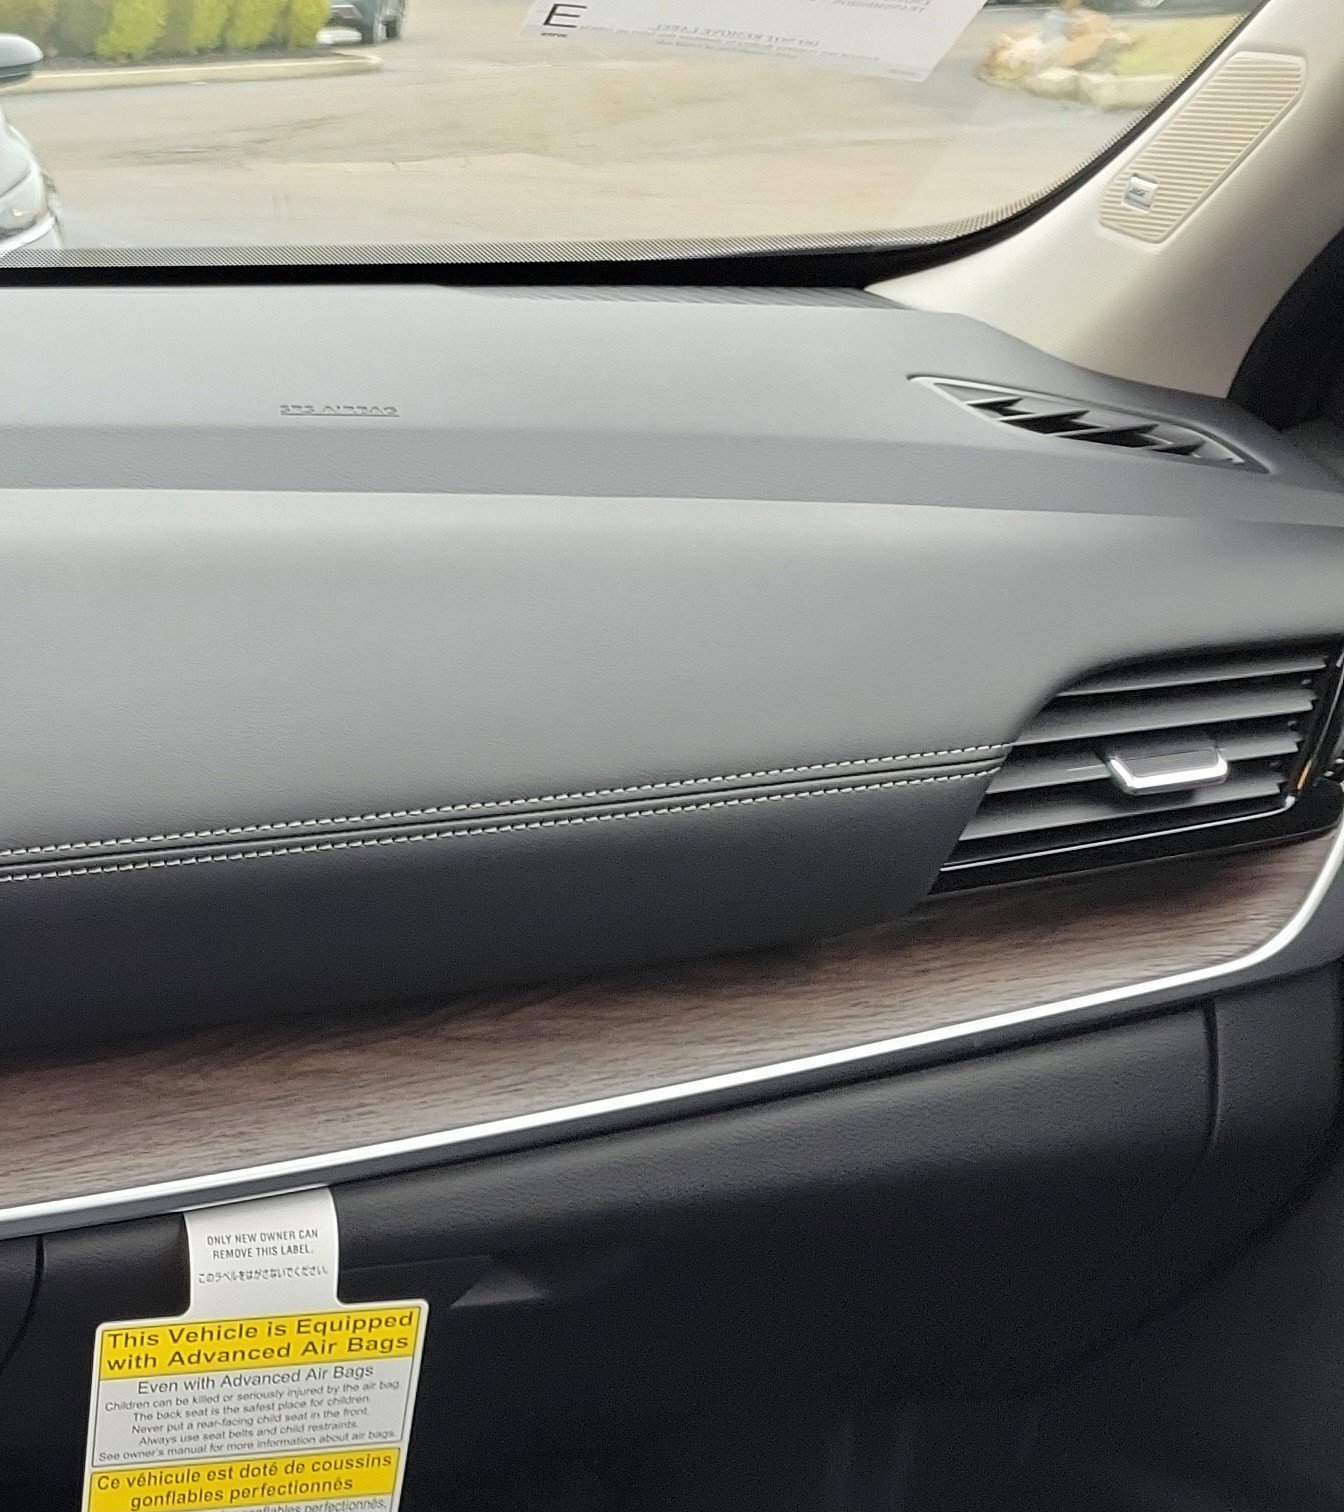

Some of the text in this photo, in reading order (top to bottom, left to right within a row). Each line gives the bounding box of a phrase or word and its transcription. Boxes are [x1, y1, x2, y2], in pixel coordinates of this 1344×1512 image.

[207, 1228, 317, 1246] ONLY NEW OWNER CAN
[212, 1247, 252, 1260] REMOVE
[256, 1245, 277, 1258] THIS
[108, 1312, 412, 1349] This Vehicle is Equipped
[107, 1334, 407, 1372] with Advanced Air Bags
[138, 1364, 373, 1395] Even with Advanced Air Bags
[97, 1454, 391, 1490] Ce véhicule est doté de coussins
[131, 1477, 352, 1512] gonflables perfectionnés
